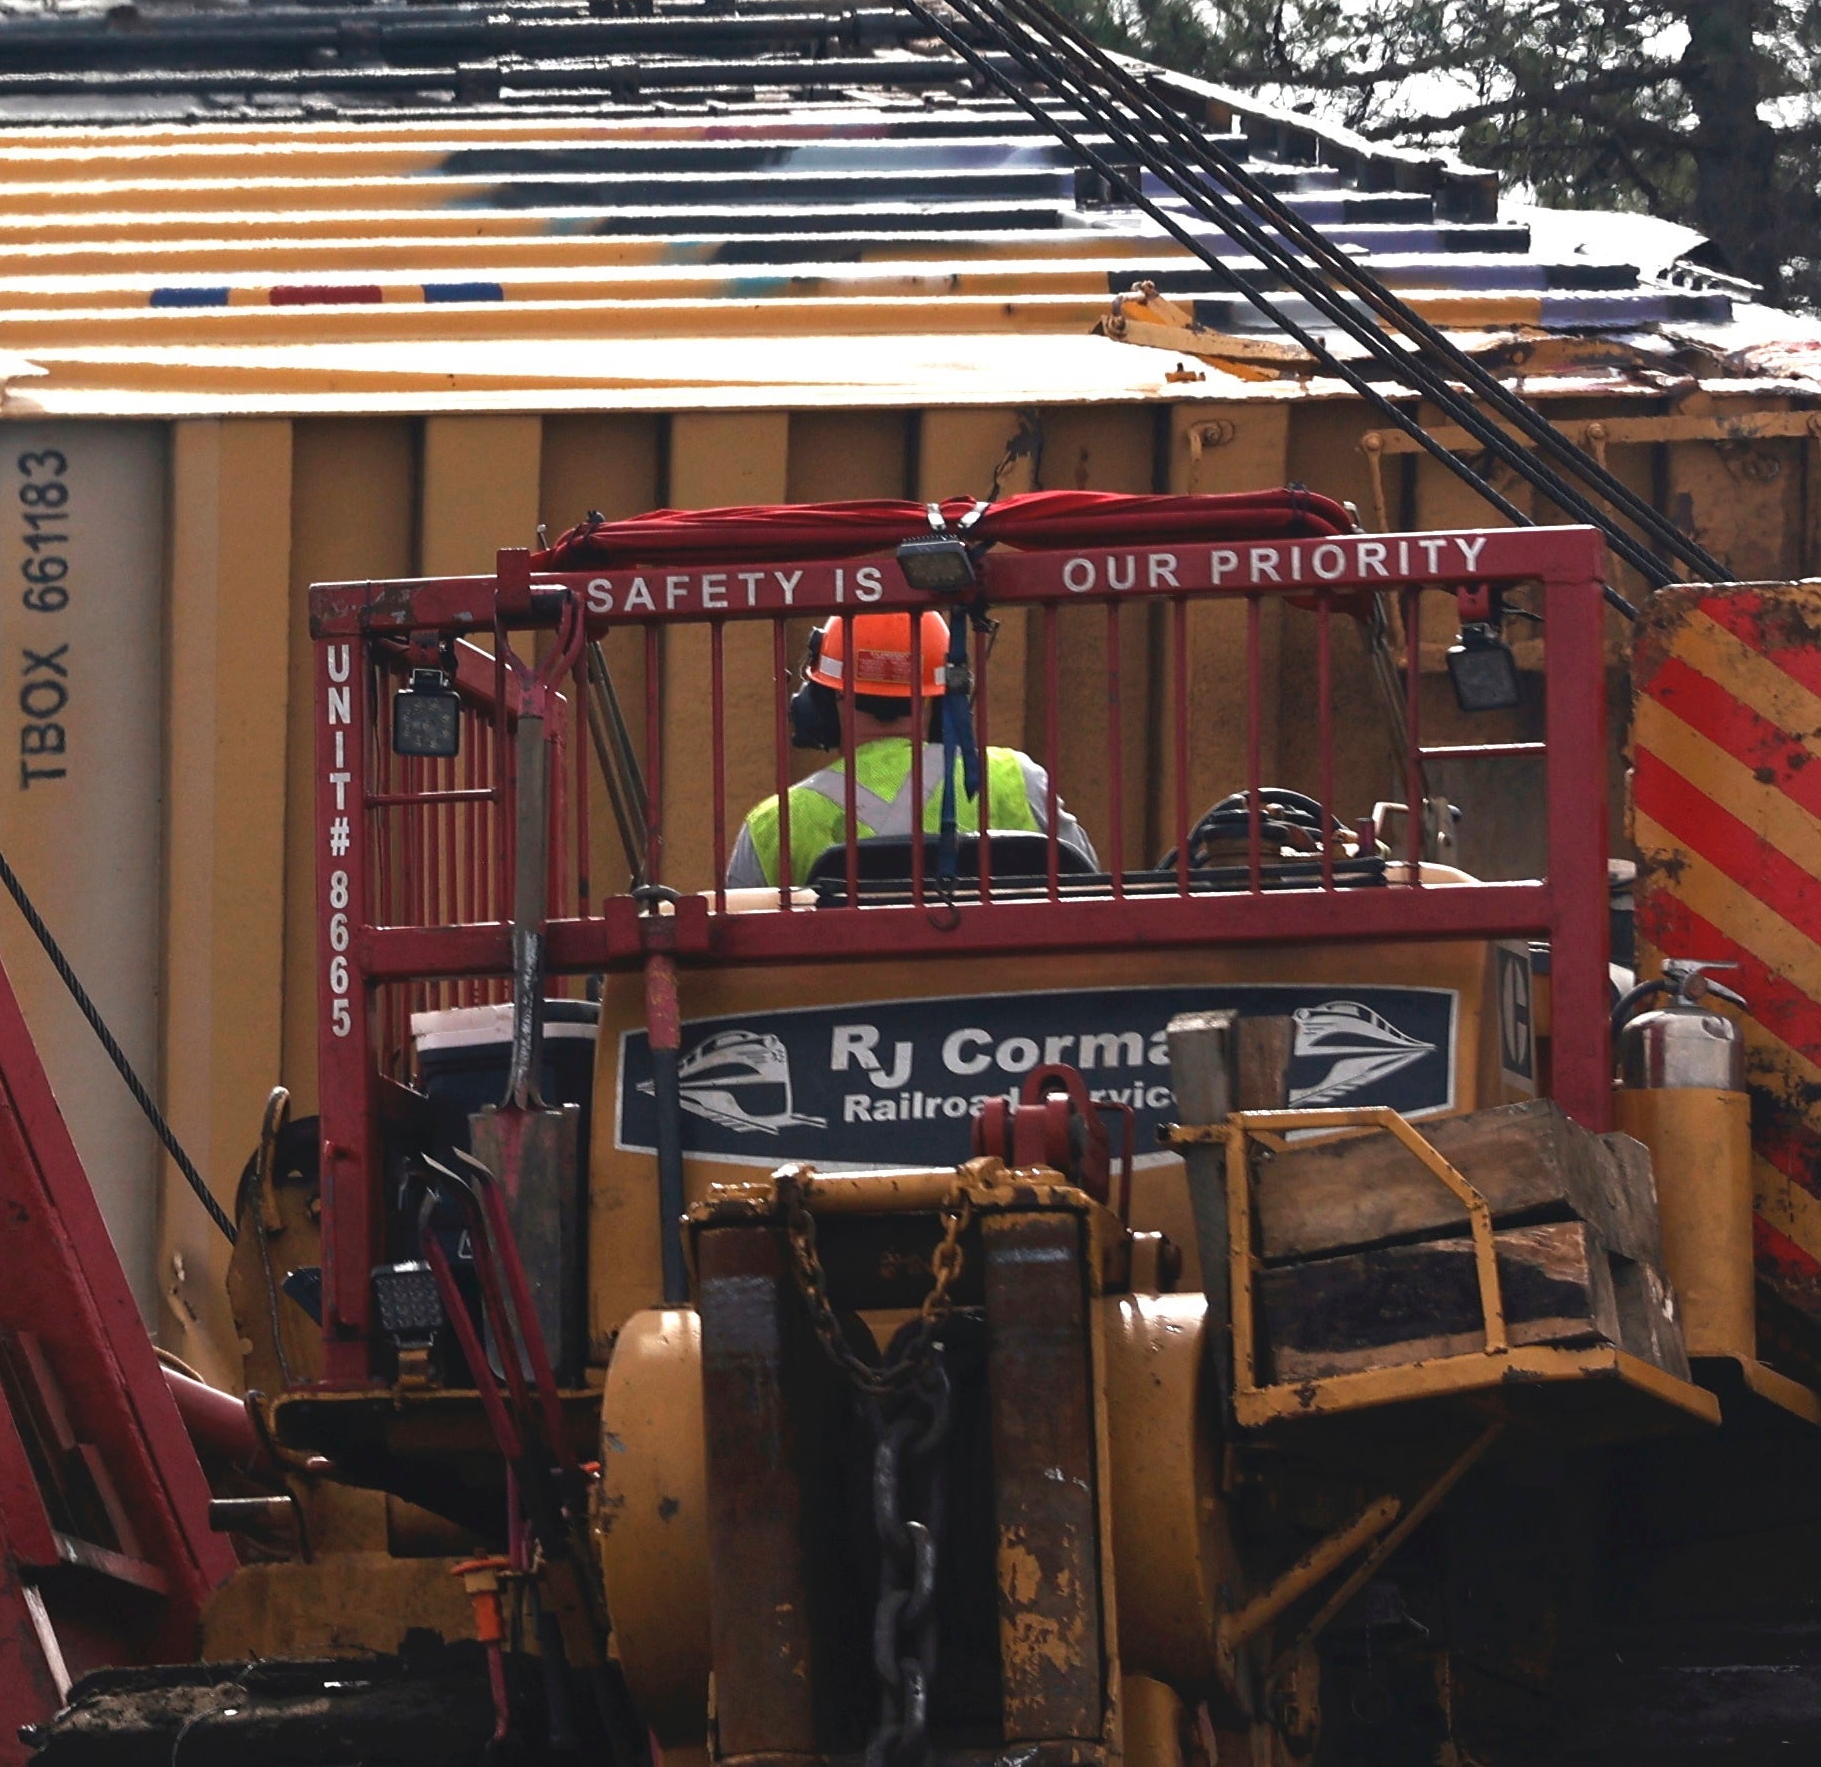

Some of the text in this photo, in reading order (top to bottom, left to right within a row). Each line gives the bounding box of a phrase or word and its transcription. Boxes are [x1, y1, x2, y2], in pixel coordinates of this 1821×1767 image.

[586, 537, 1487, 614] SAFETY IS OUR PRIORITY
[18, 448, 70, 792] TBOX 661183
[831, 1024, 1172, 1090] RJ Corma
